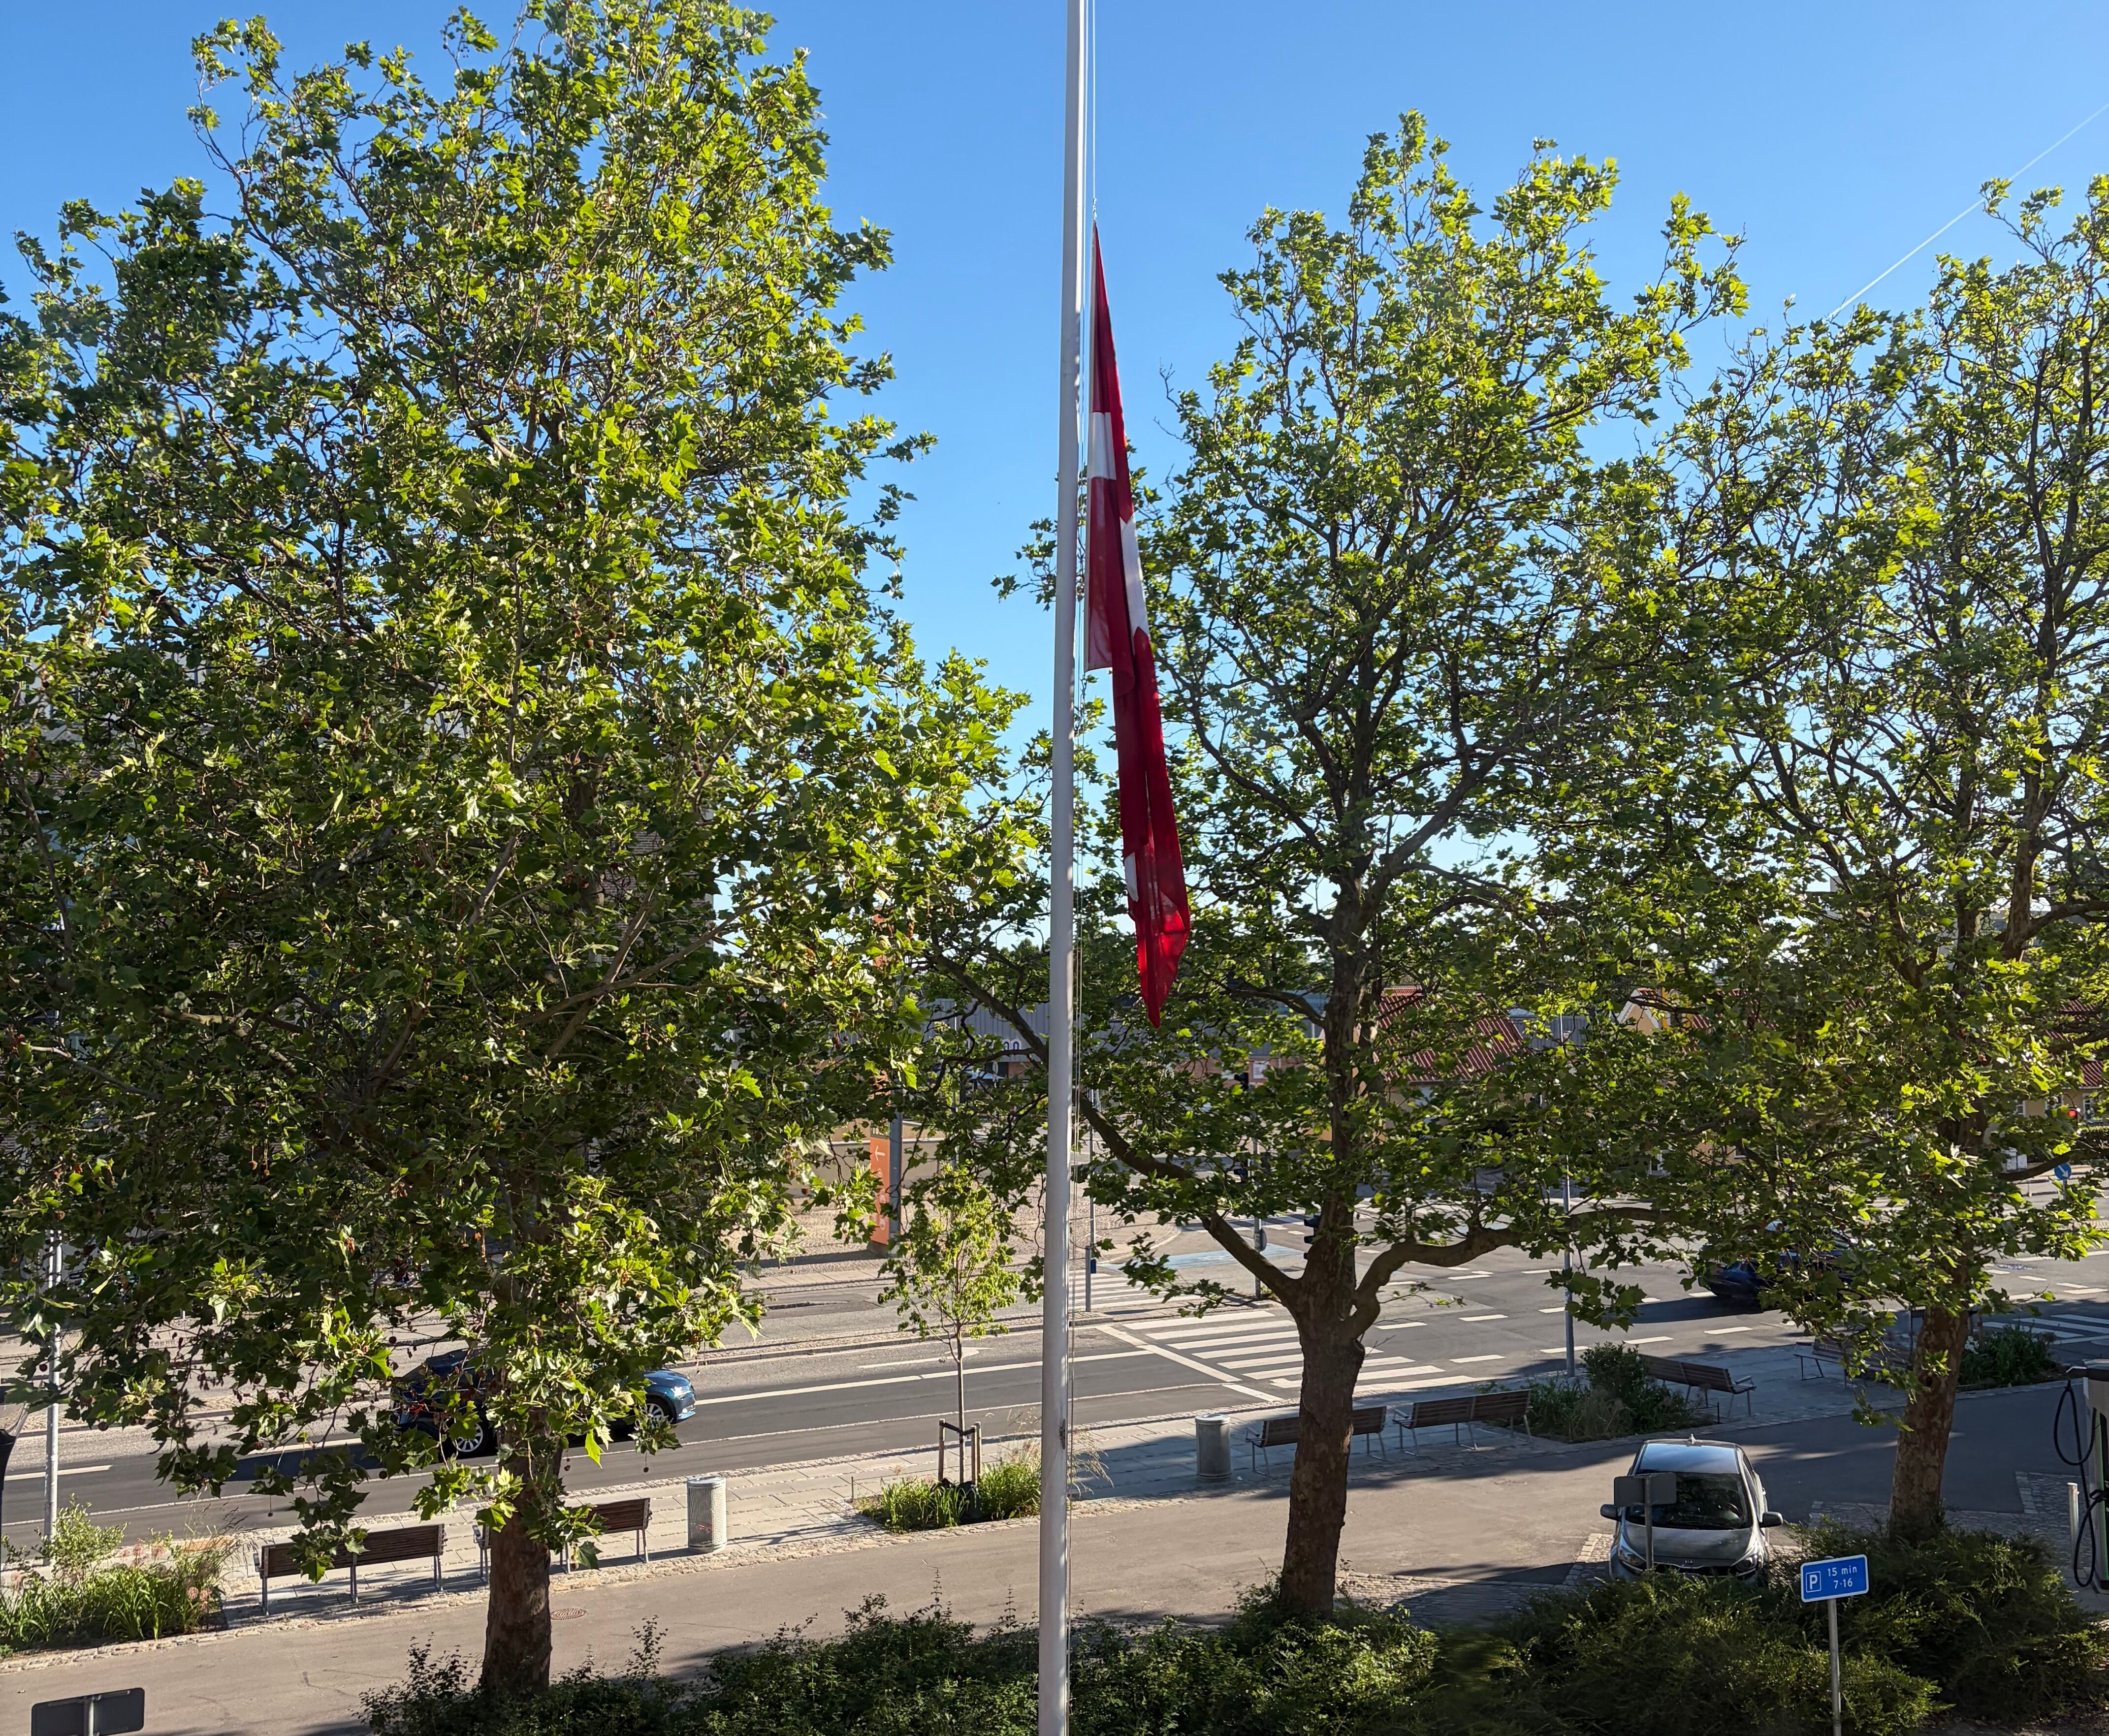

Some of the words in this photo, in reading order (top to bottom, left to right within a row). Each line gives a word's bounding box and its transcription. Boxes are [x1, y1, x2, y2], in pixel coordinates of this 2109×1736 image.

[1827, 1567, 1837, 1577] 15
[1841, 1565, 1857, 1575] min
[1809, 1574, 1818, 1590] P
[1833, 1578, 1853, 1589] 7-16
